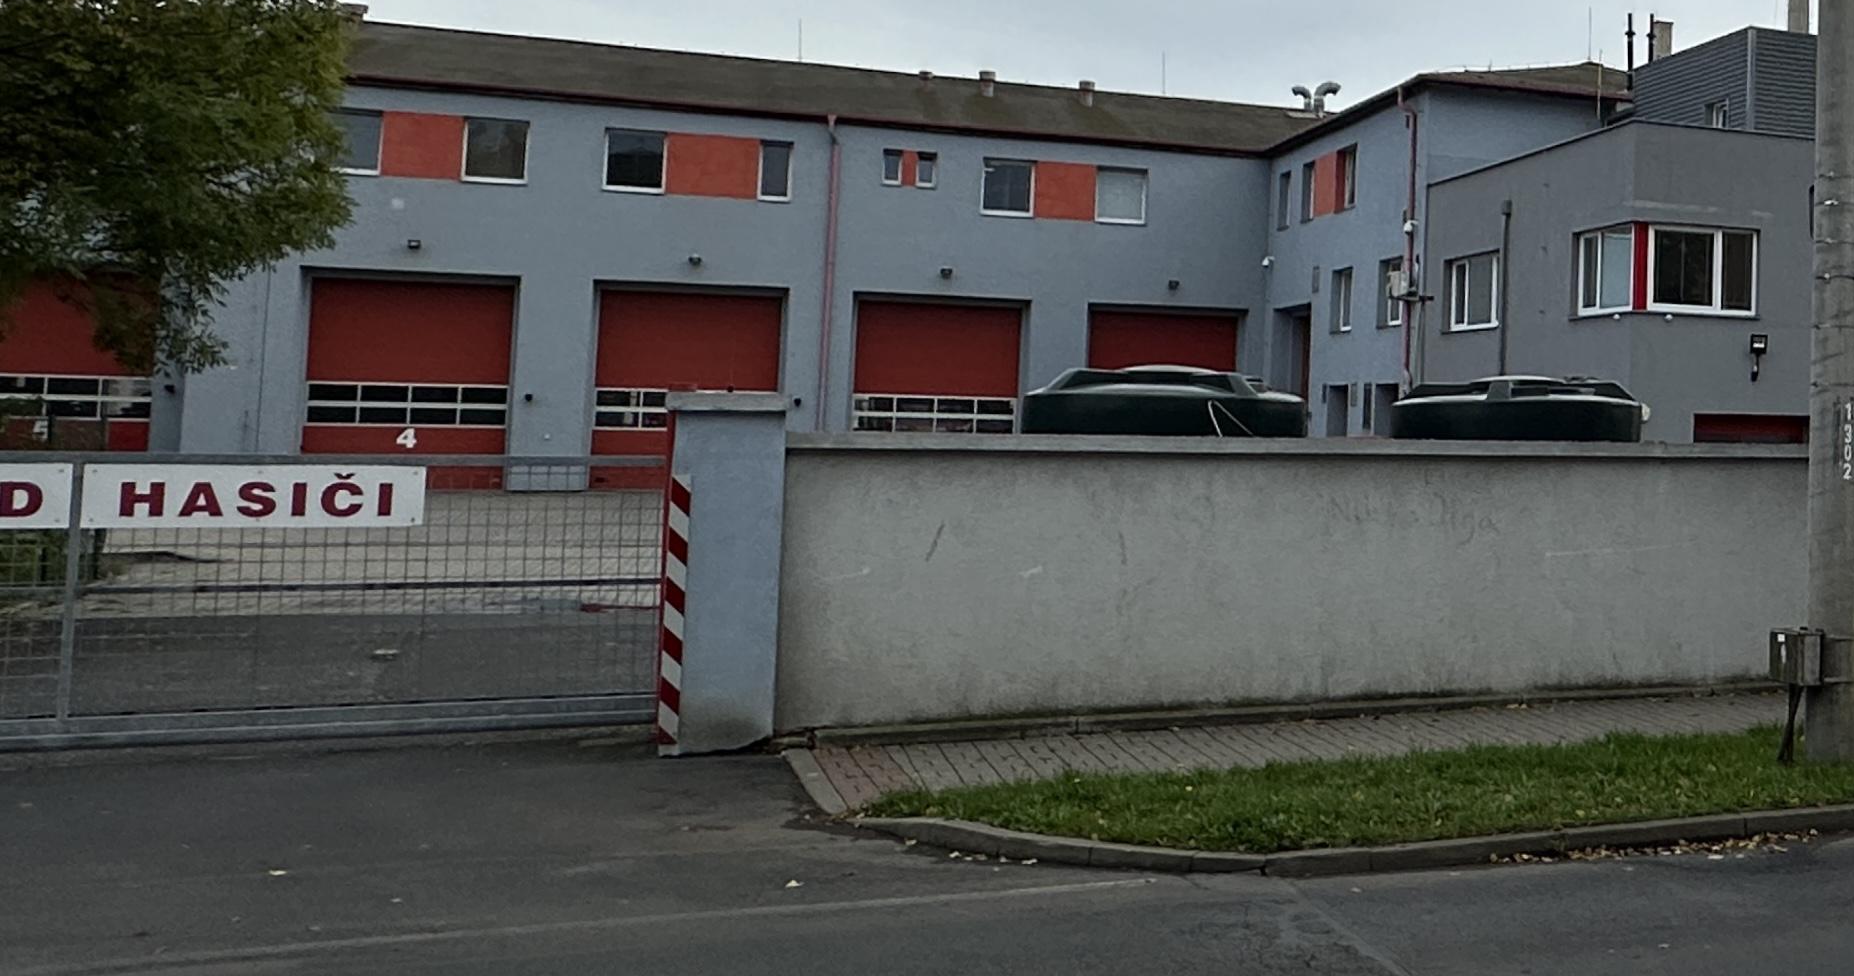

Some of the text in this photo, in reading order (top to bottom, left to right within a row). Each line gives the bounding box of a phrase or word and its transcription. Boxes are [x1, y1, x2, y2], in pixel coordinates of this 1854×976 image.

[32, 419, 48, 442] 5
[396, 427, 417, 448] 4
[1843, 402, 1852, 480] 1302
[118, 472, 394, 518] HASIČI
